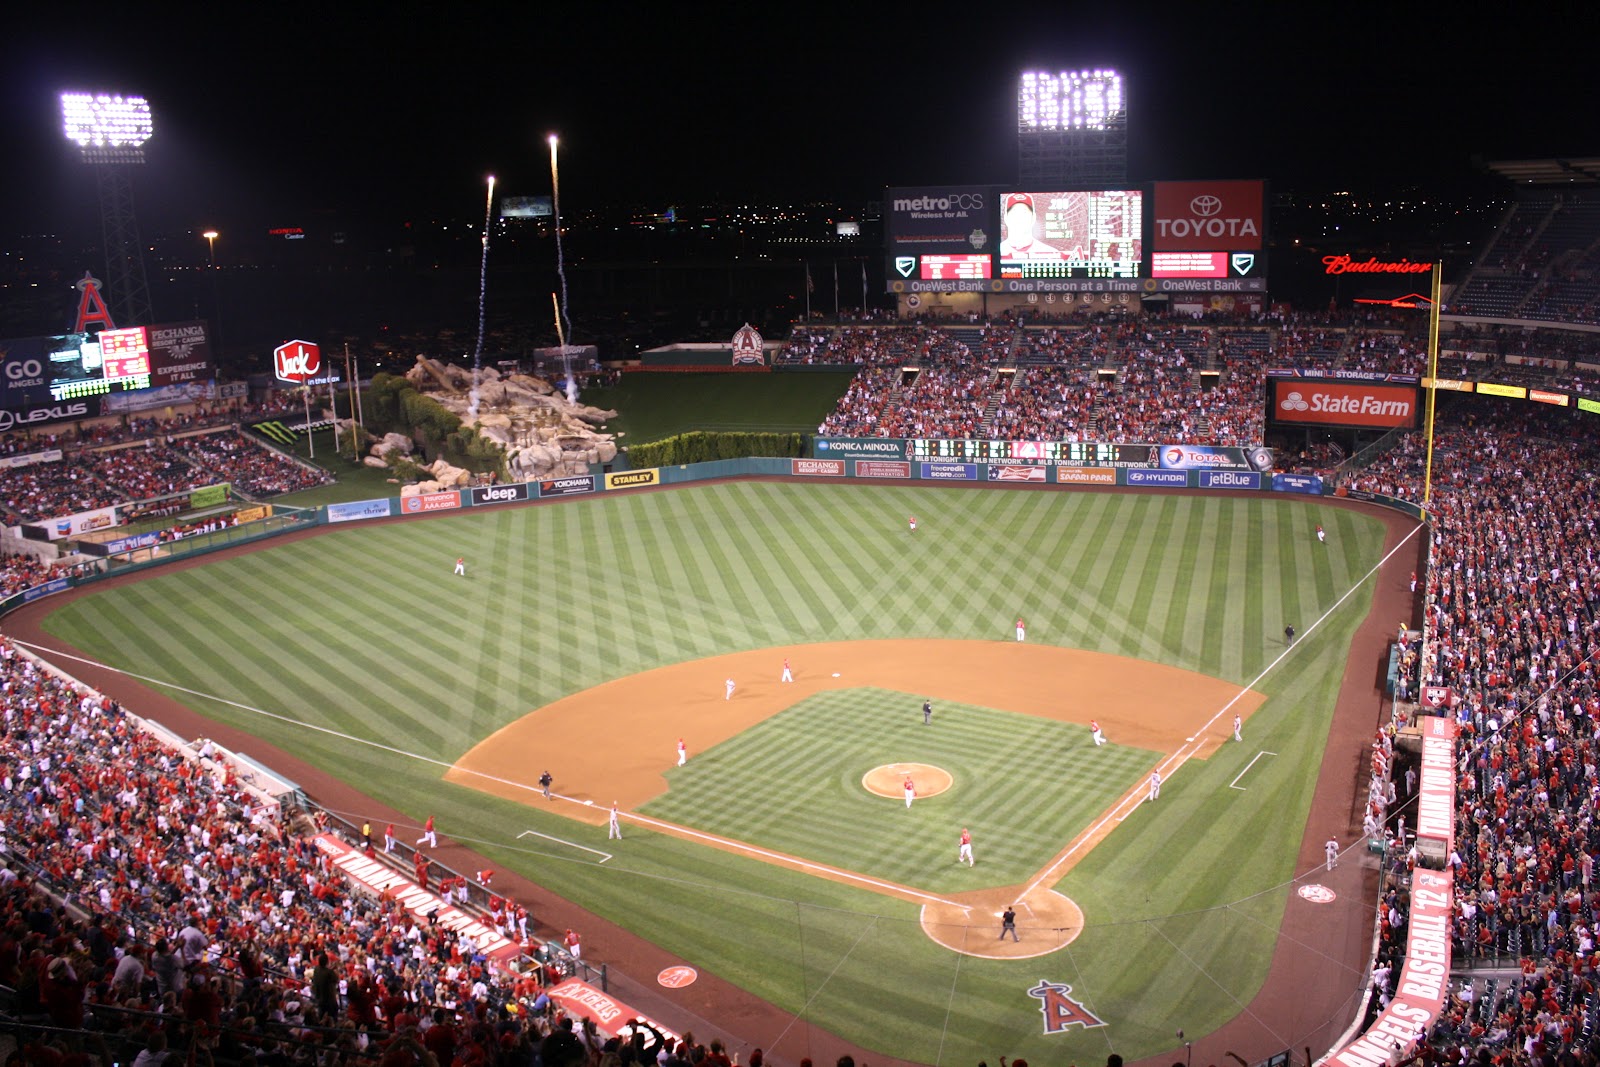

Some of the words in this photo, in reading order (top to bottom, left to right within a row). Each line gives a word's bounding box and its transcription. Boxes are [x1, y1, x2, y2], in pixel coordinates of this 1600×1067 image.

[894, 193, 984, 211] metroPCS
[1156, 218, 1258, 237] TOYOTA
[1321, 255, 1432, 275] Budweiser
[911, 280, 956, 292] OneWest
[958, 280, 984, 291] Bank
[1009, 280, 1035, 292] One
[1037, 280, 1078, 292] Person
[1080, 281, 1092, 291] at
[1095, 282, 1102, 291] a
[1107, 280, 1138, 291] Time
[1162, 279, 1211, 291] OneWest
[1214, 279, 1241, 291] Bank
[151, 326, 205, 340] PECHANGA
[152, 339, 176, 347] RESORT
[279, 345, 320, 378] Jack
[5, 359, 42, 379] GO
[157, 362, 207, 375] EXPERIENCE
[1304, 369, 1324, 378] MINI
[170, 374, 178, 382] IT
[180, 372, 196, 380] ALL
[8, 378, 43, 389] ANGELS!
[1310, 392, 1359, 414] State
[1360, 395, 1410, 417] Farm
[15, 403, 88, 423] LEXUS
[829, 442, 862, 451] KONICA
[862, 442, 900, 452] MINOLTA
[930, 455, 959, 463] TONIGHT
[988, 457, 1023, 465] NETWORK
[1054, 459, 1084, 467] TONIGHT
[1187, 452, 1232, 463] TOTAL
[797, 461, 840, 469] PECHANGA
[1114, 461, 1149, 469] NETWORK
[553, 478, 591, 488] YOKOHAMA
[613, 473, 652, 485] STANLEY
[1060, 472, 1090, 481] SAFARI
[1090, 473, 1113, 482] PARK
[1146, 474, 1185, 482] HYUNDAI
[1209, 472, 1250, 486] jetBlue
[423, 493, 455, 502] Insurance
[482, 487, 517, 501] Jeep
[364, 507, 387, 515] thrive
[424, 501, 456, 510] AAA.com
[1423, 736, 1451, 766] FANS!
[1422, 767, 1451, 793] YOU
[1419, 792, 1451, 835] THANK
[332, 849, 409, 892] THANK
[396, 884, 449, 917] YOU
[1402, 913, 1446, 1000] BASEBALL
[548, 982, 623, 1025] ANGELS
